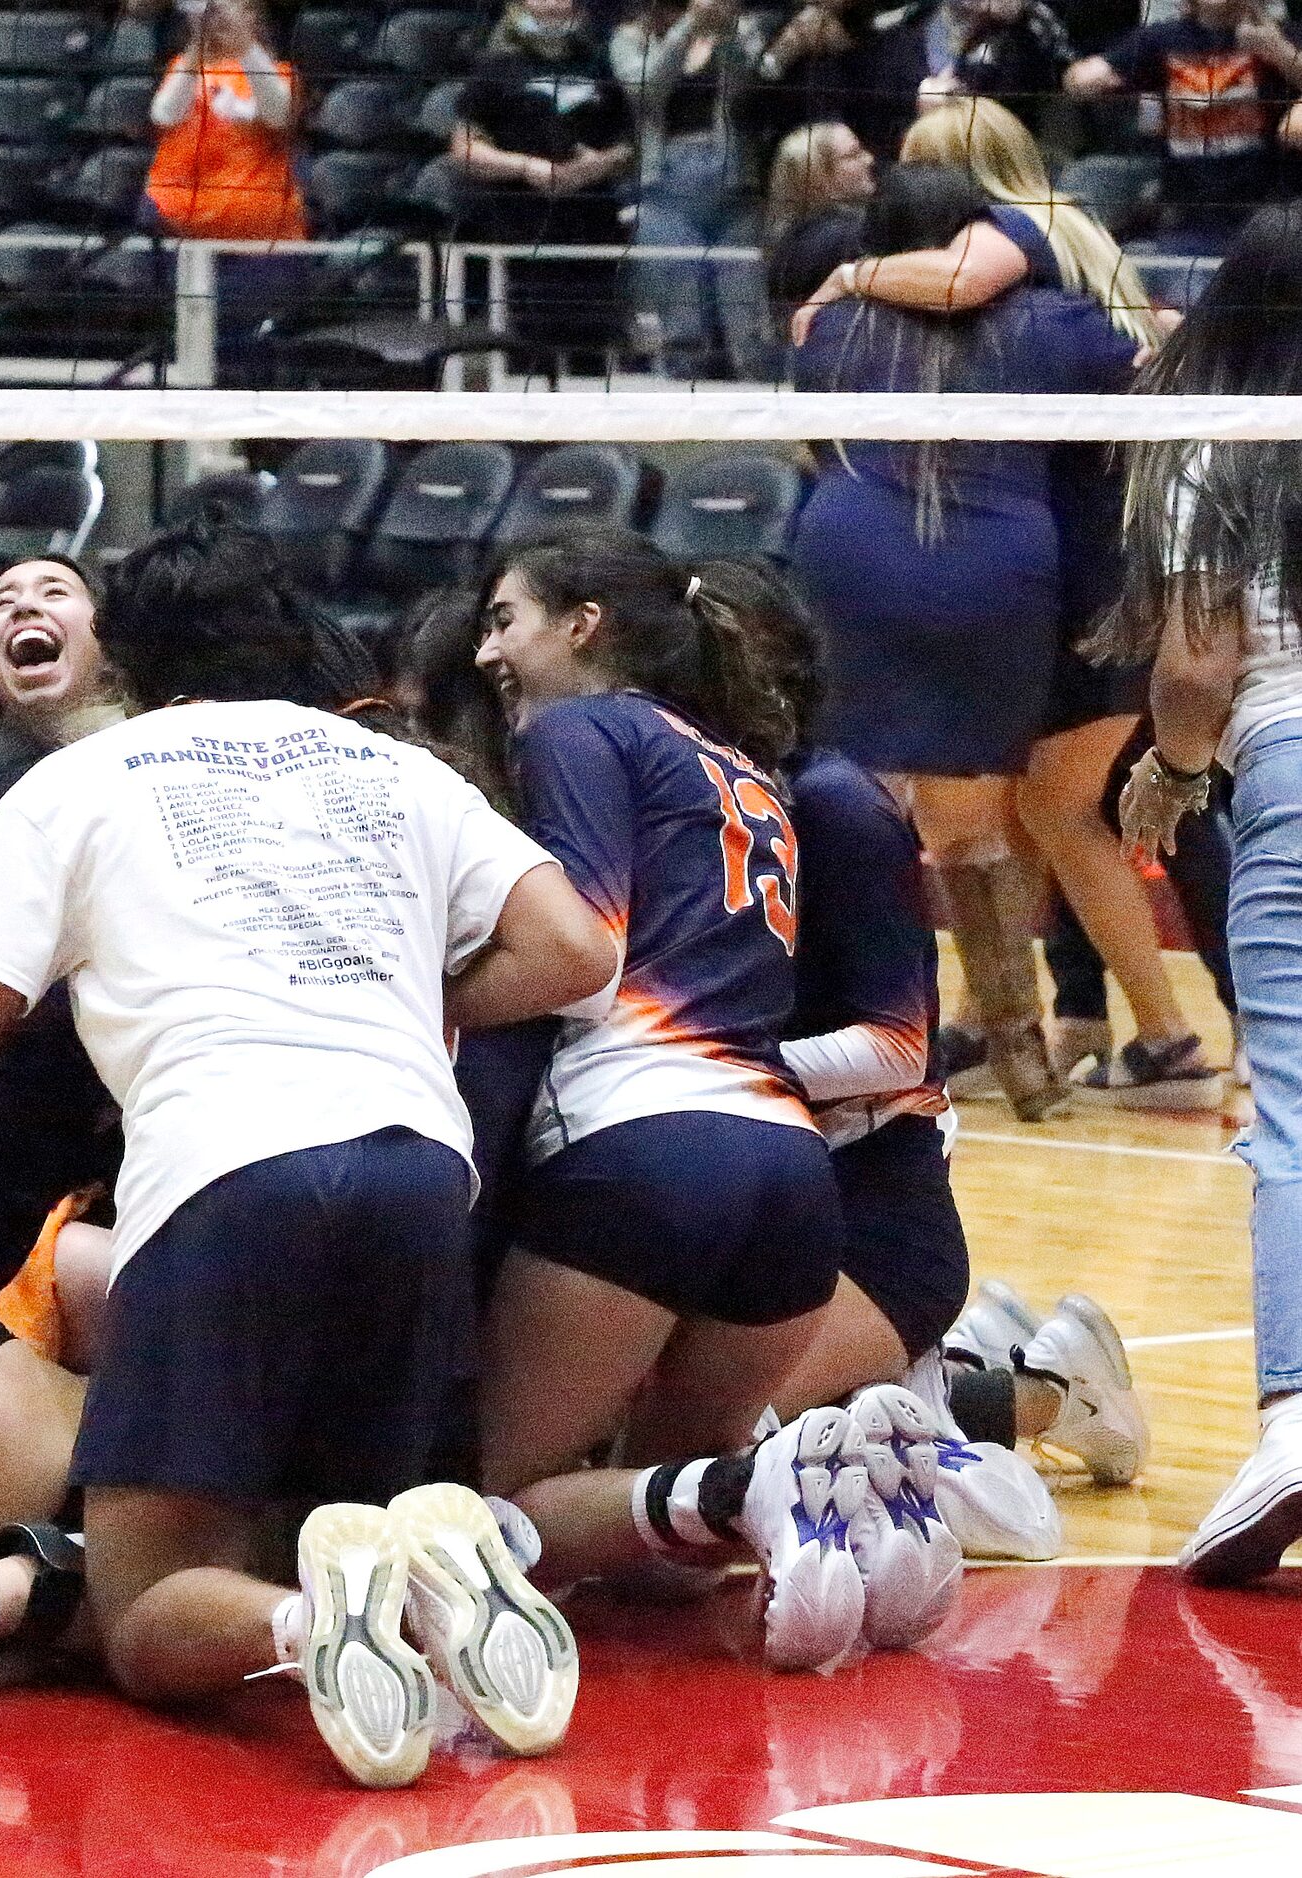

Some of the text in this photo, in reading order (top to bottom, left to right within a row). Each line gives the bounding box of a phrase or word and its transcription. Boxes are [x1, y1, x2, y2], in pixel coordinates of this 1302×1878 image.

[192, 728, 327, 753] STATE 2021
[124, 750, 247, 770] BRANDEIS
[275, 763, 304, 777] FOR
[172, 809, 205, 820] BELLA
[176, 817, 204, 829] ANNA
[209, 812, 250, 822] JORDAN
[179, 821, 237, 838] SAMANTHA
[182, 835, 210, 848] LOLA
[697, 752, 798, 957] 13
[176, 861, 182, 869] 9
[298, 954, 374, 970] #BIGgoals
